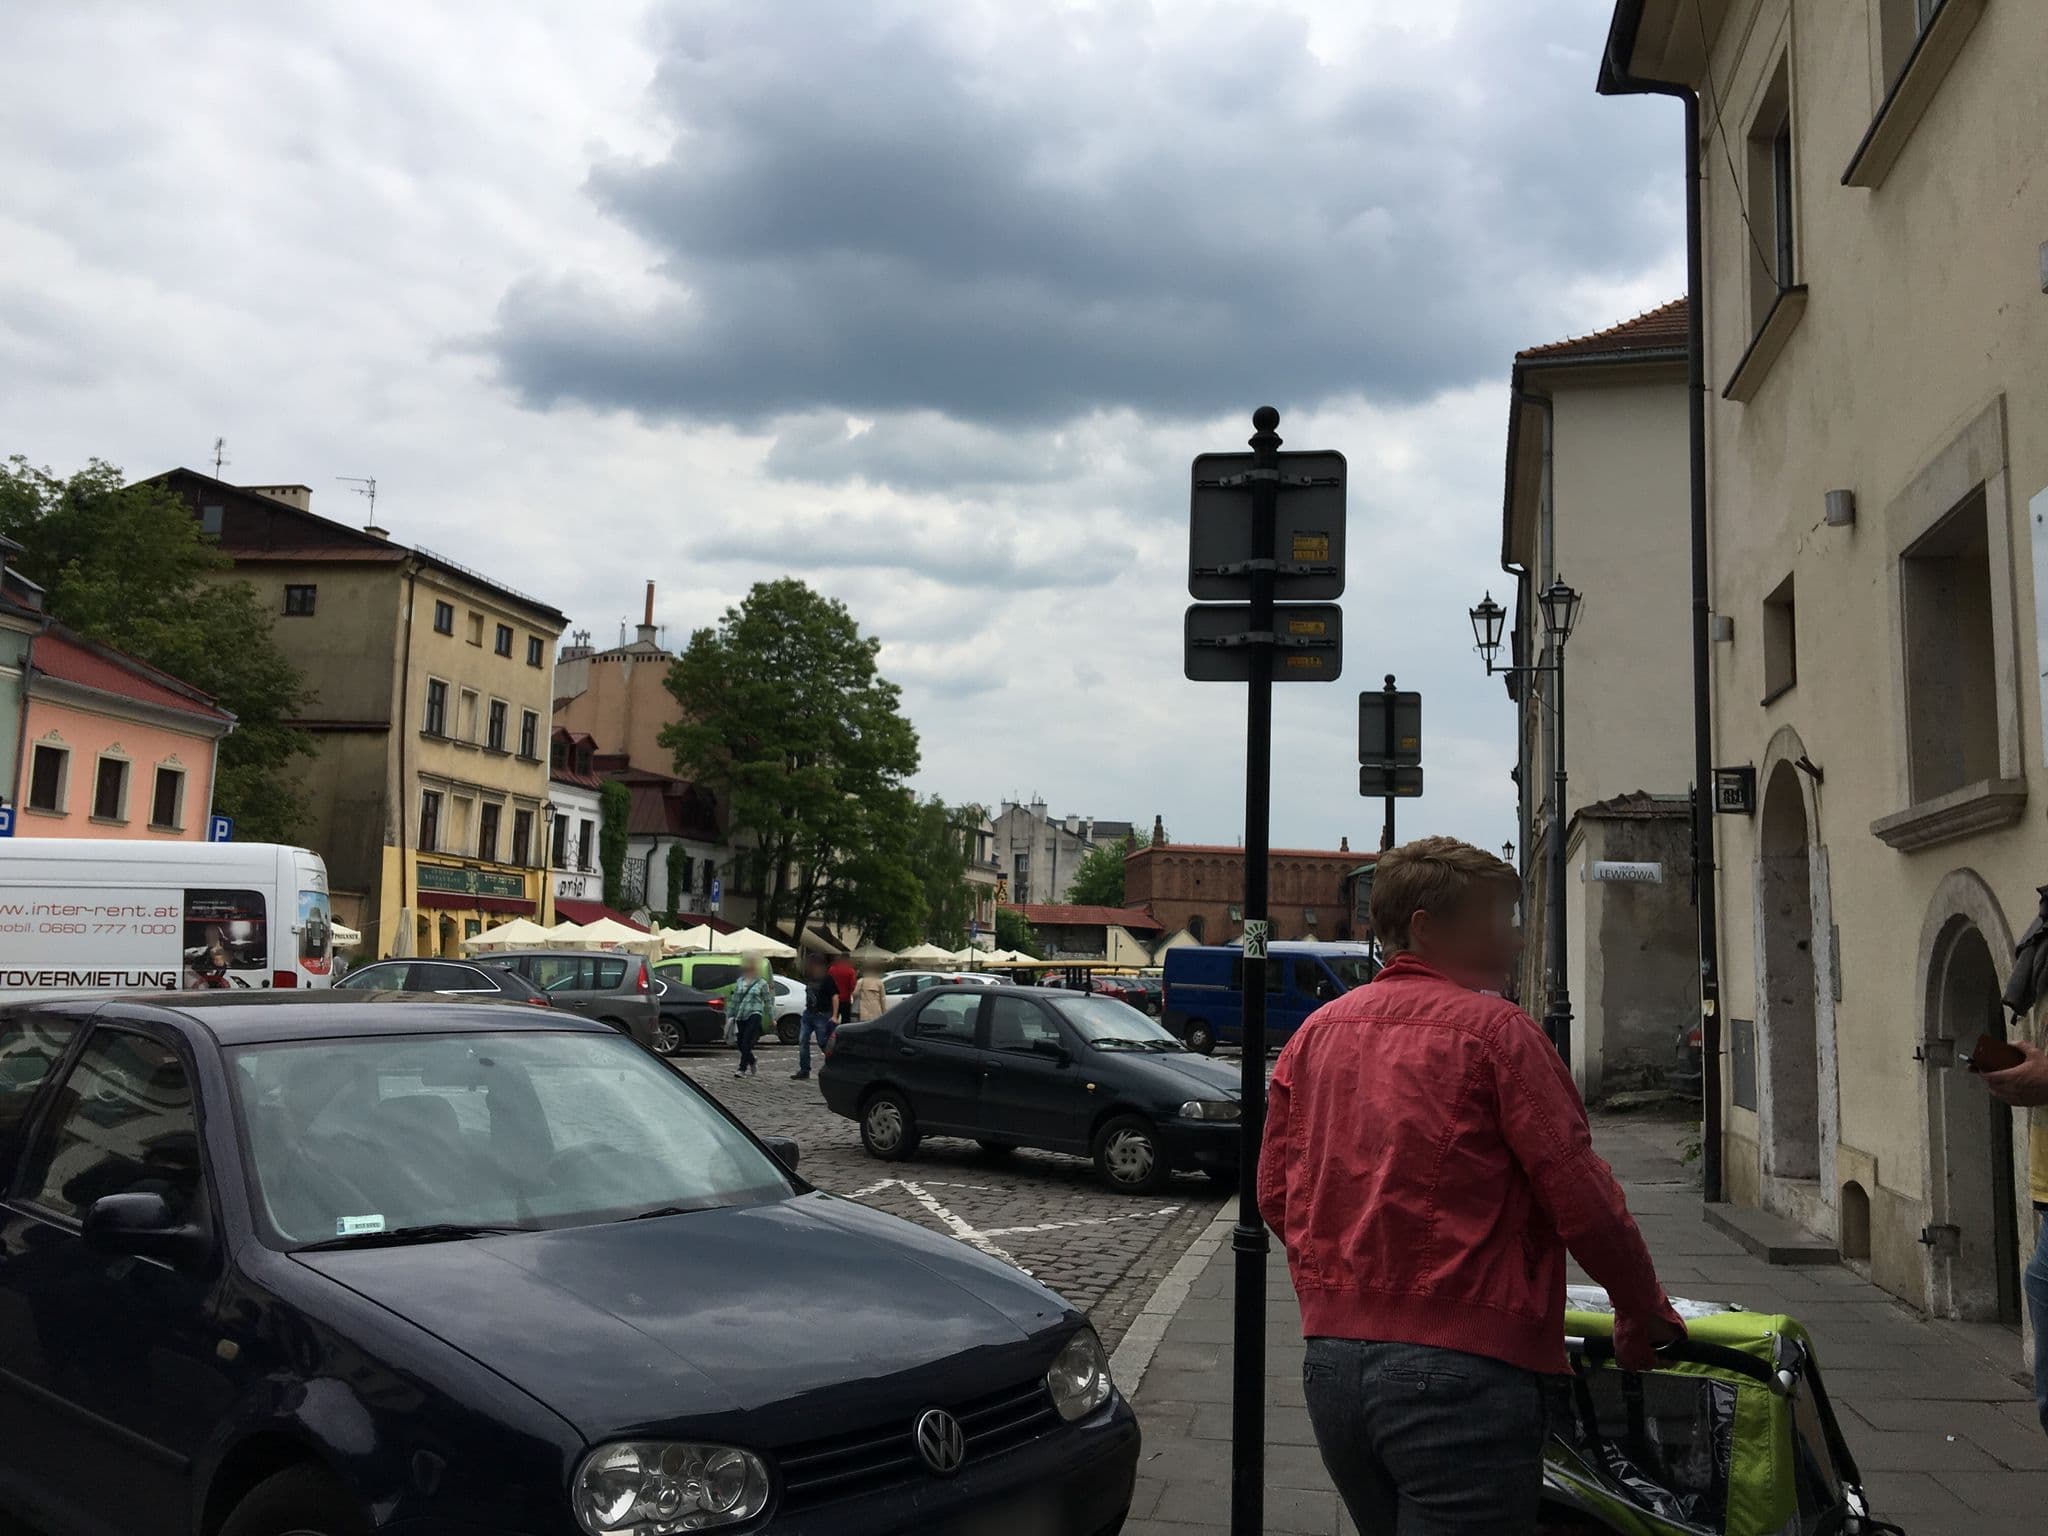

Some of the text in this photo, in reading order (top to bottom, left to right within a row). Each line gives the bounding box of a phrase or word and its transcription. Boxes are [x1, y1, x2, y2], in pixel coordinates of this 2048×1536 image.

[214, 819, 229, 842] P
[1599, 868, 1655, 880] LEWKOWA
[92, 923, 127, 935] 777
[130, 923, 177, 935] 1000
